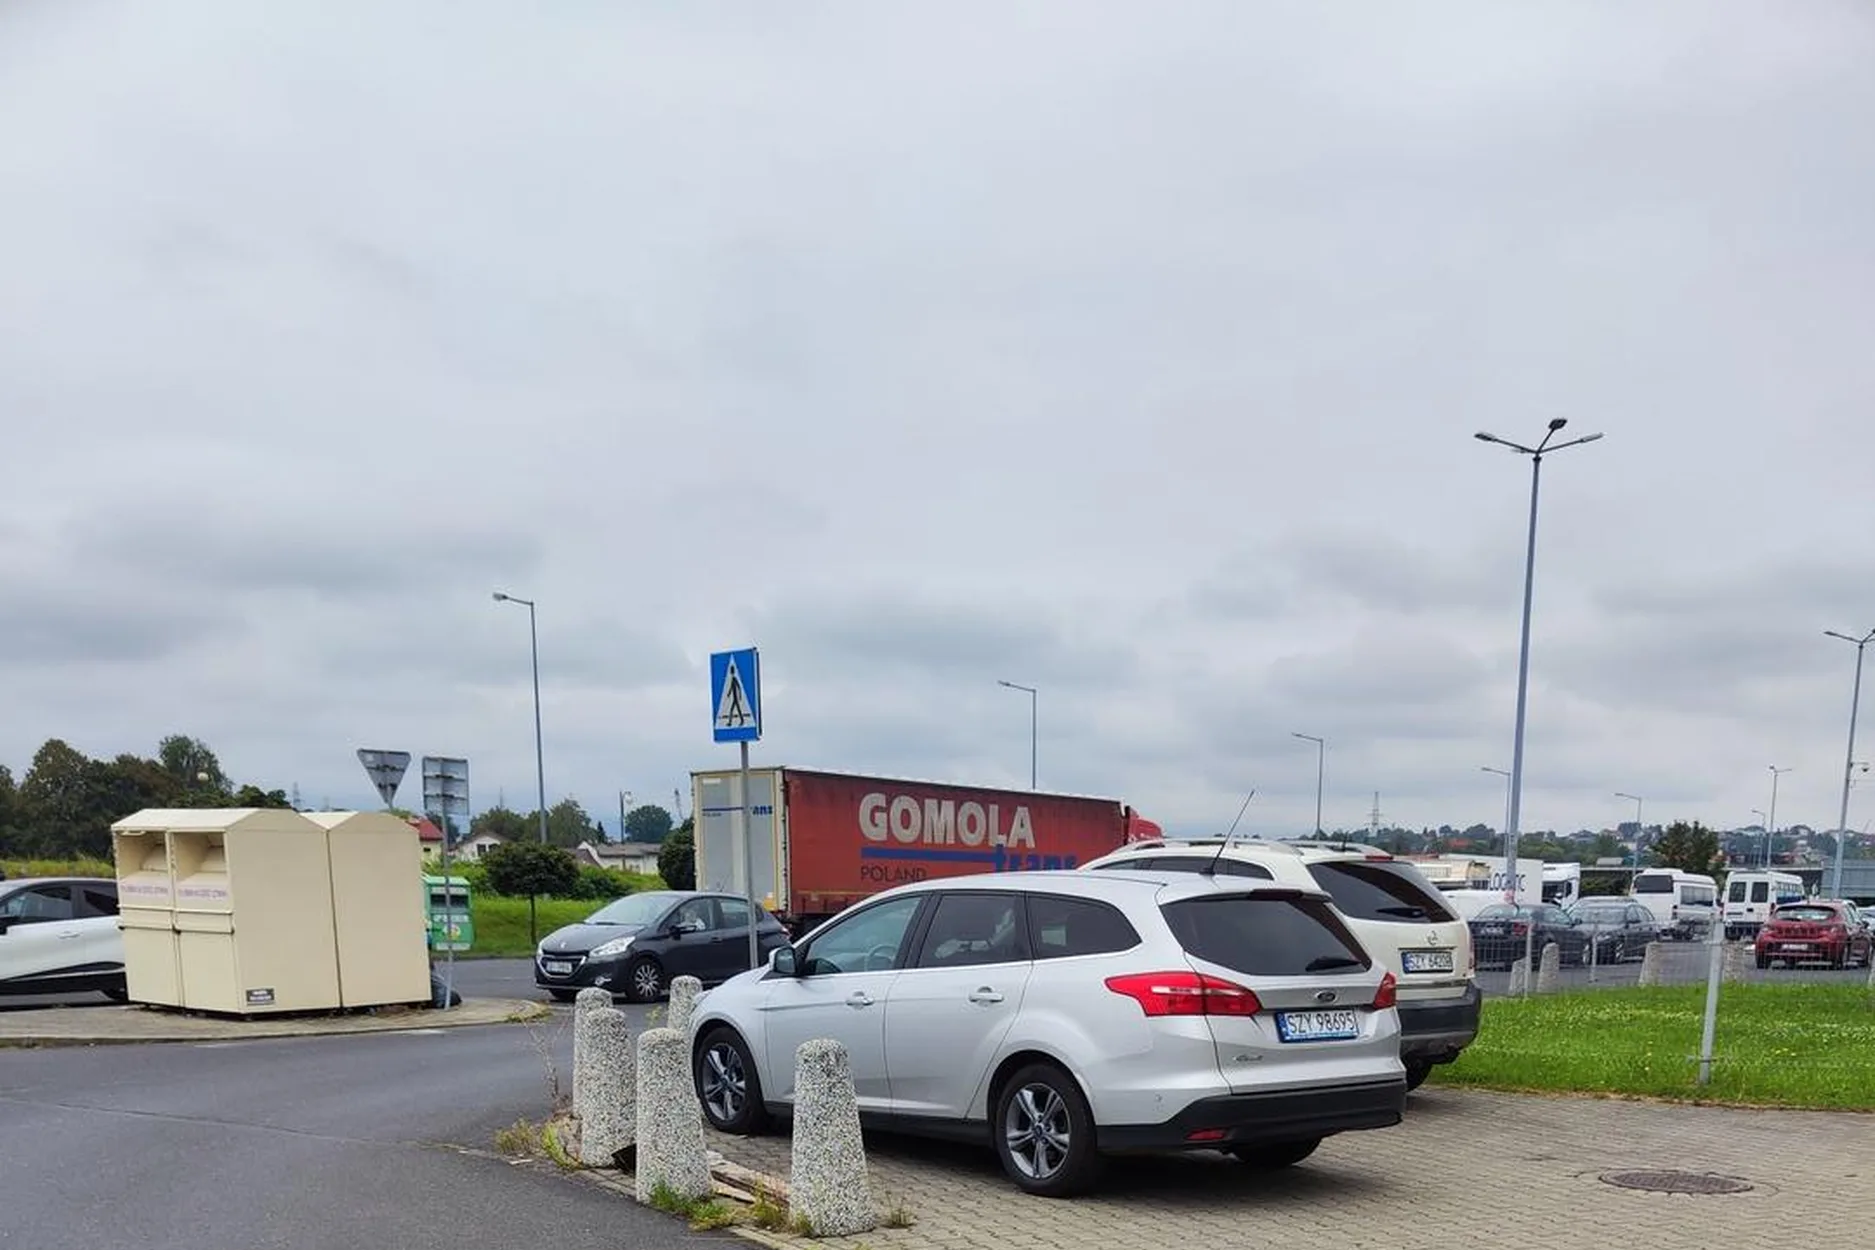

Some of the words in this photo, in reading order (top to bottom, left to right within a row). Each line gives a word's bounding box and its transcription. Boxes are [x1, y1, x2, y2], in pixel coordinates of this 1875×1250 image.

[859, 793, 1035, 848] GOMOLA
[860, 865, 927, 882] POLAND
[1287, 1012, 1312, 1034] SZY
[1315, 1010, 1355, 1032] 98695
